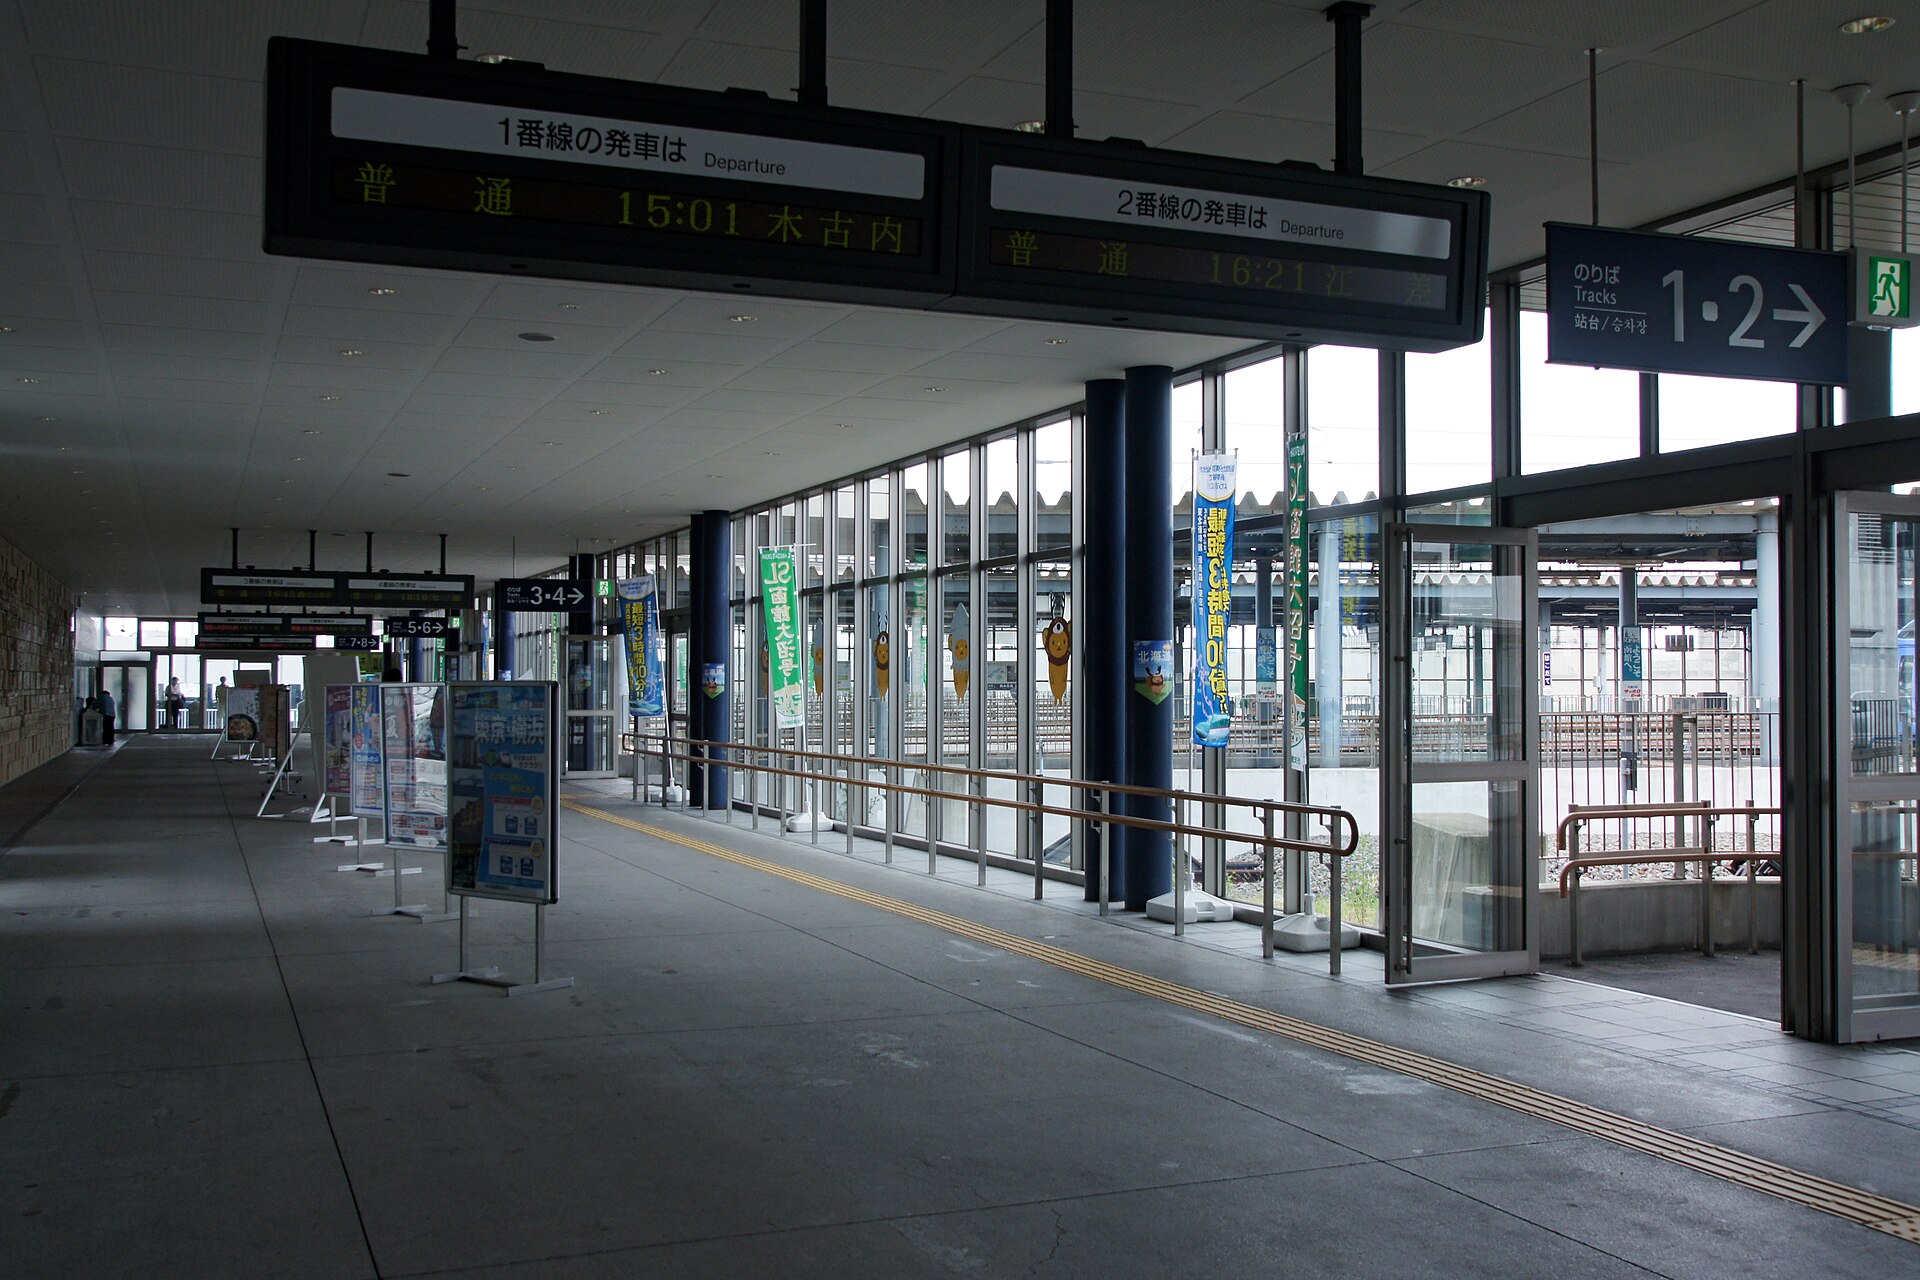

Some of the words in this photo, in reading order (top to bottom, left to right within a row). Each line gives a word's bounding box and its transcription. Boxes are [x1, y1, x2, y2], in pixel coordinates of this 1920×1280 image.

[498, 116, 687, 164] 1番線の発車は
[704, 152, 786, 177] Departure
[616, 190, 741, 237] 15:01
[1117, 190, 1268, 231] 2番線の発車は
[1280, 219, 1345, 241] Departure
[1208, 253, 1305, 292] 16:21
[1573, 262, 1622, 286] のりば
[1573, 285, 1618, 307] Tracks
[1138, 650, 1171, 662] 北海道
